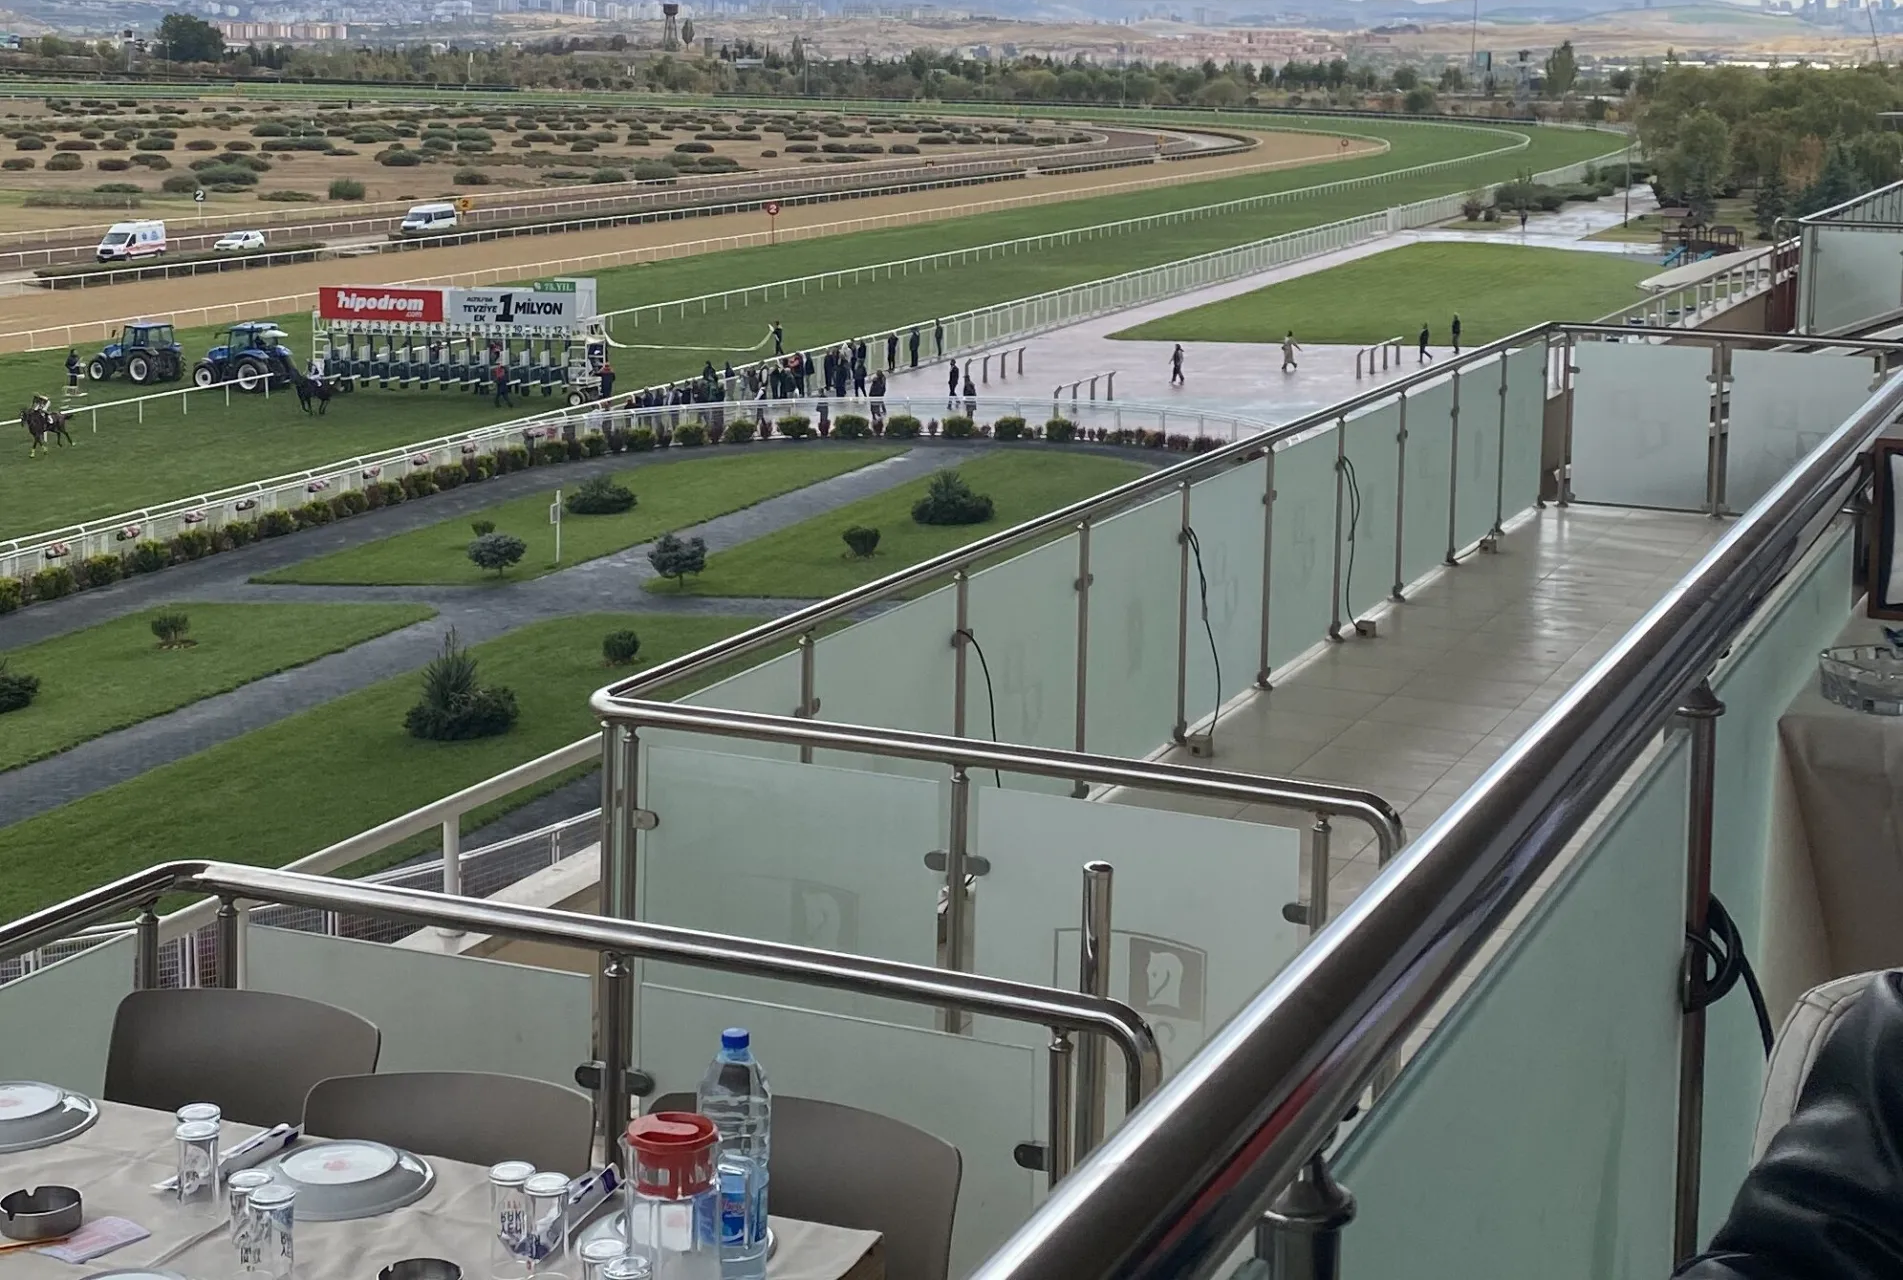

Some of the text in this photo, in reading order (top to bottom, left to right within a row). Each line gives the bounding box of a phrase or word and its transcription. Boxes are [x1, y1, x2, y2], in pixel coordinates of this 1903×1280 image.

[195, 190, 204, 201] 2
[462, 199, 469, 208] 2
[769, 204, 777, 213] 2
[337, 291, 424, 312] hipodrom
[463, 303, 498, 313] TEVZİYE
[495, 293, 563, 322] 1 MİLYON
[474, 314, 486, 322] EK
[513, 325, 522, 333] 10
